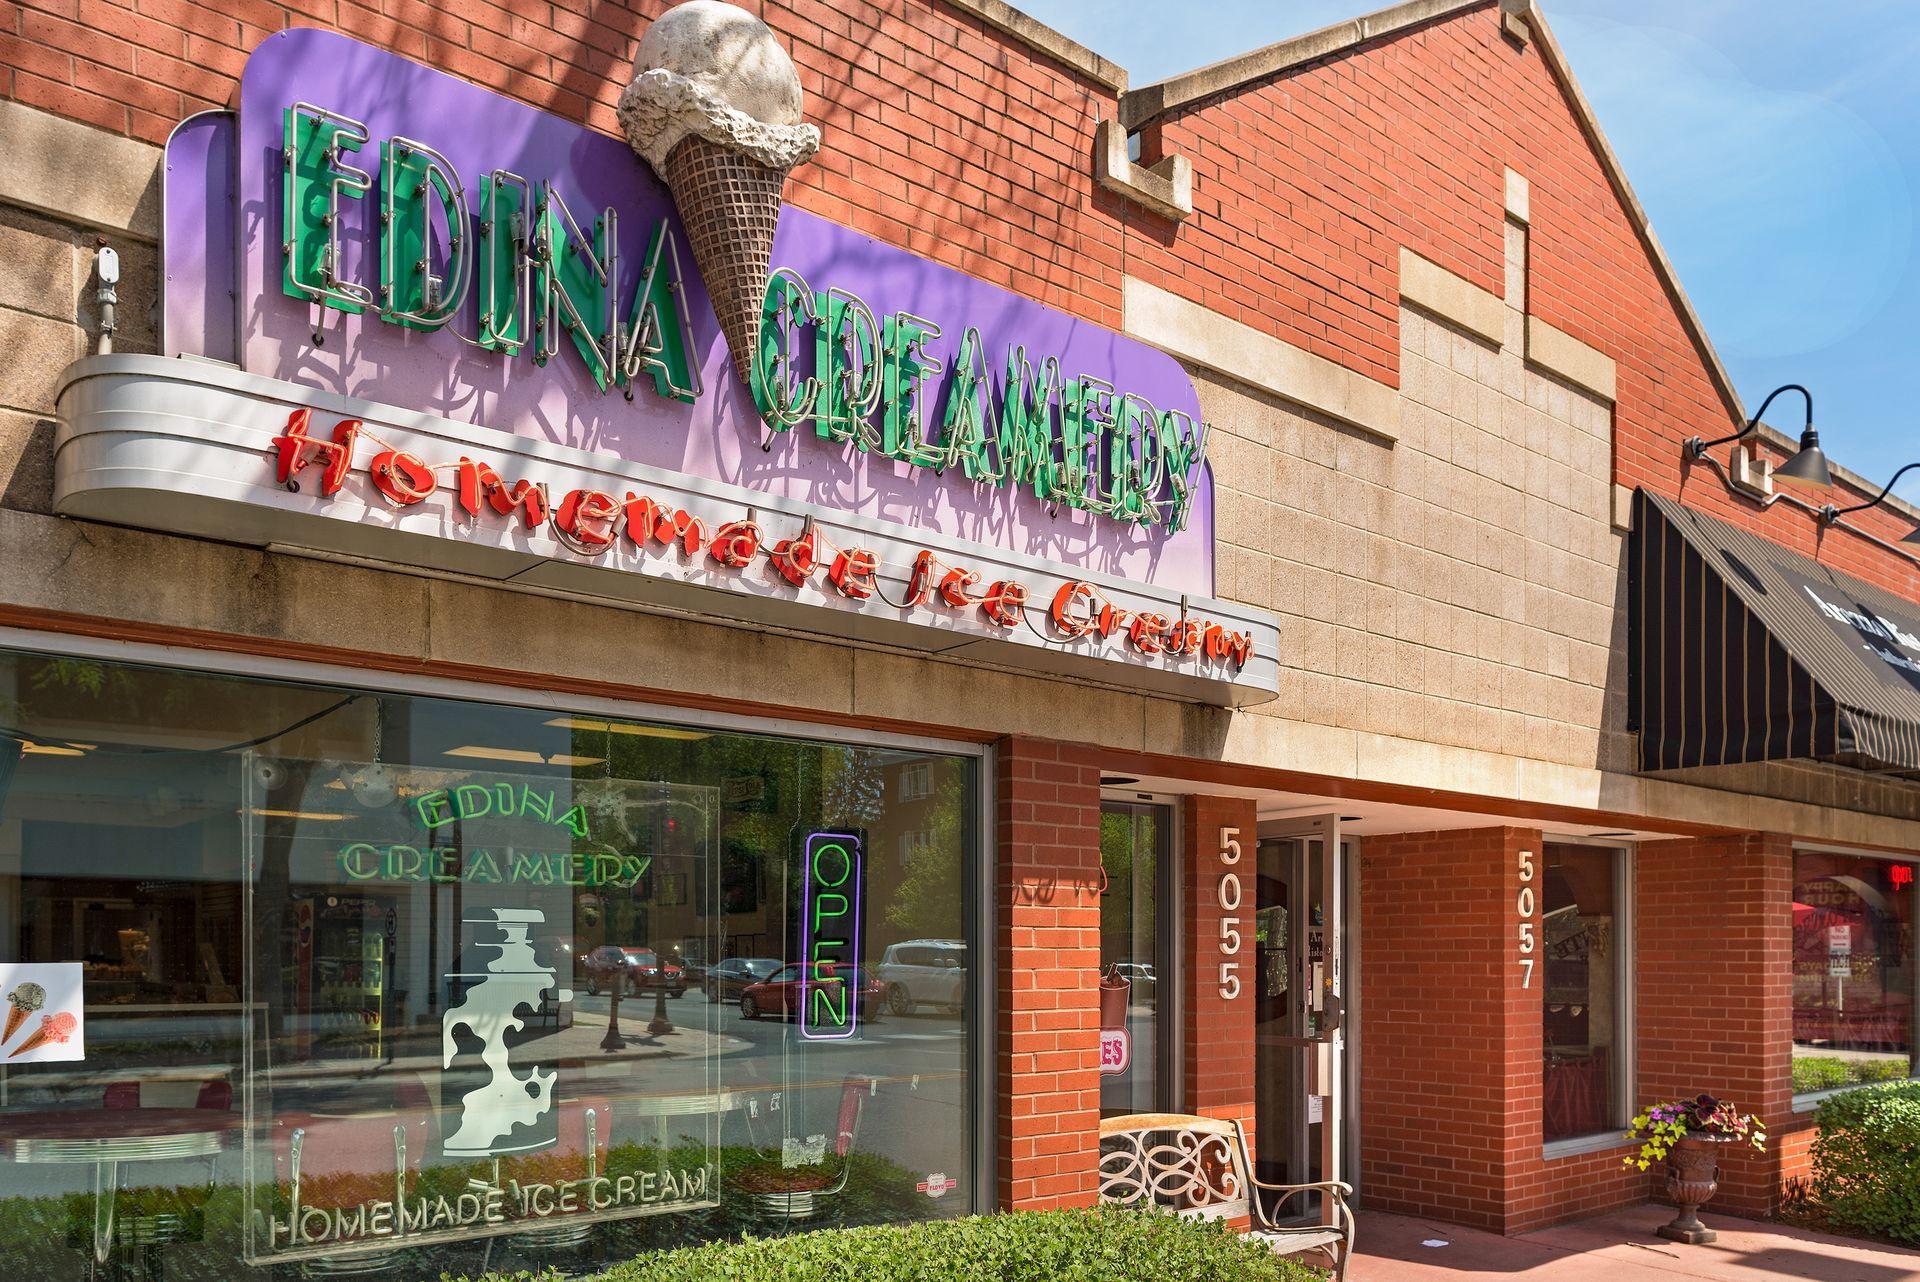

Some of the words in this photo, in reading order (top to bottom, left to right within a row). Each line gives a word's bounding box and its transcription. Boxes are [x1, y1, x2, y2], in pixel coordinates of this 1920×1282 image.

[283, 102, 704, 405] EDINA
[748, 266, 1212, 534] CREAMERY
[272, 407, 884, 600] Homemade
[908, 549, 1030, 627] Ice
[1050, 580, 1256, 673] Cream
[340, 843, 653, 889] CREAMERY
[411, 783, 589, 837] EDINA
[813, 843, 850, 1027] OPEN
[1218, 826, 1242, 1001] 5055
[1517, 849, 1536, 990] 5057
[269, 1188, 504, 1248] HOMEMADE
[512, 1180, 580, 1217] ICE
[590, 1167, 708, 1210] CREAM
